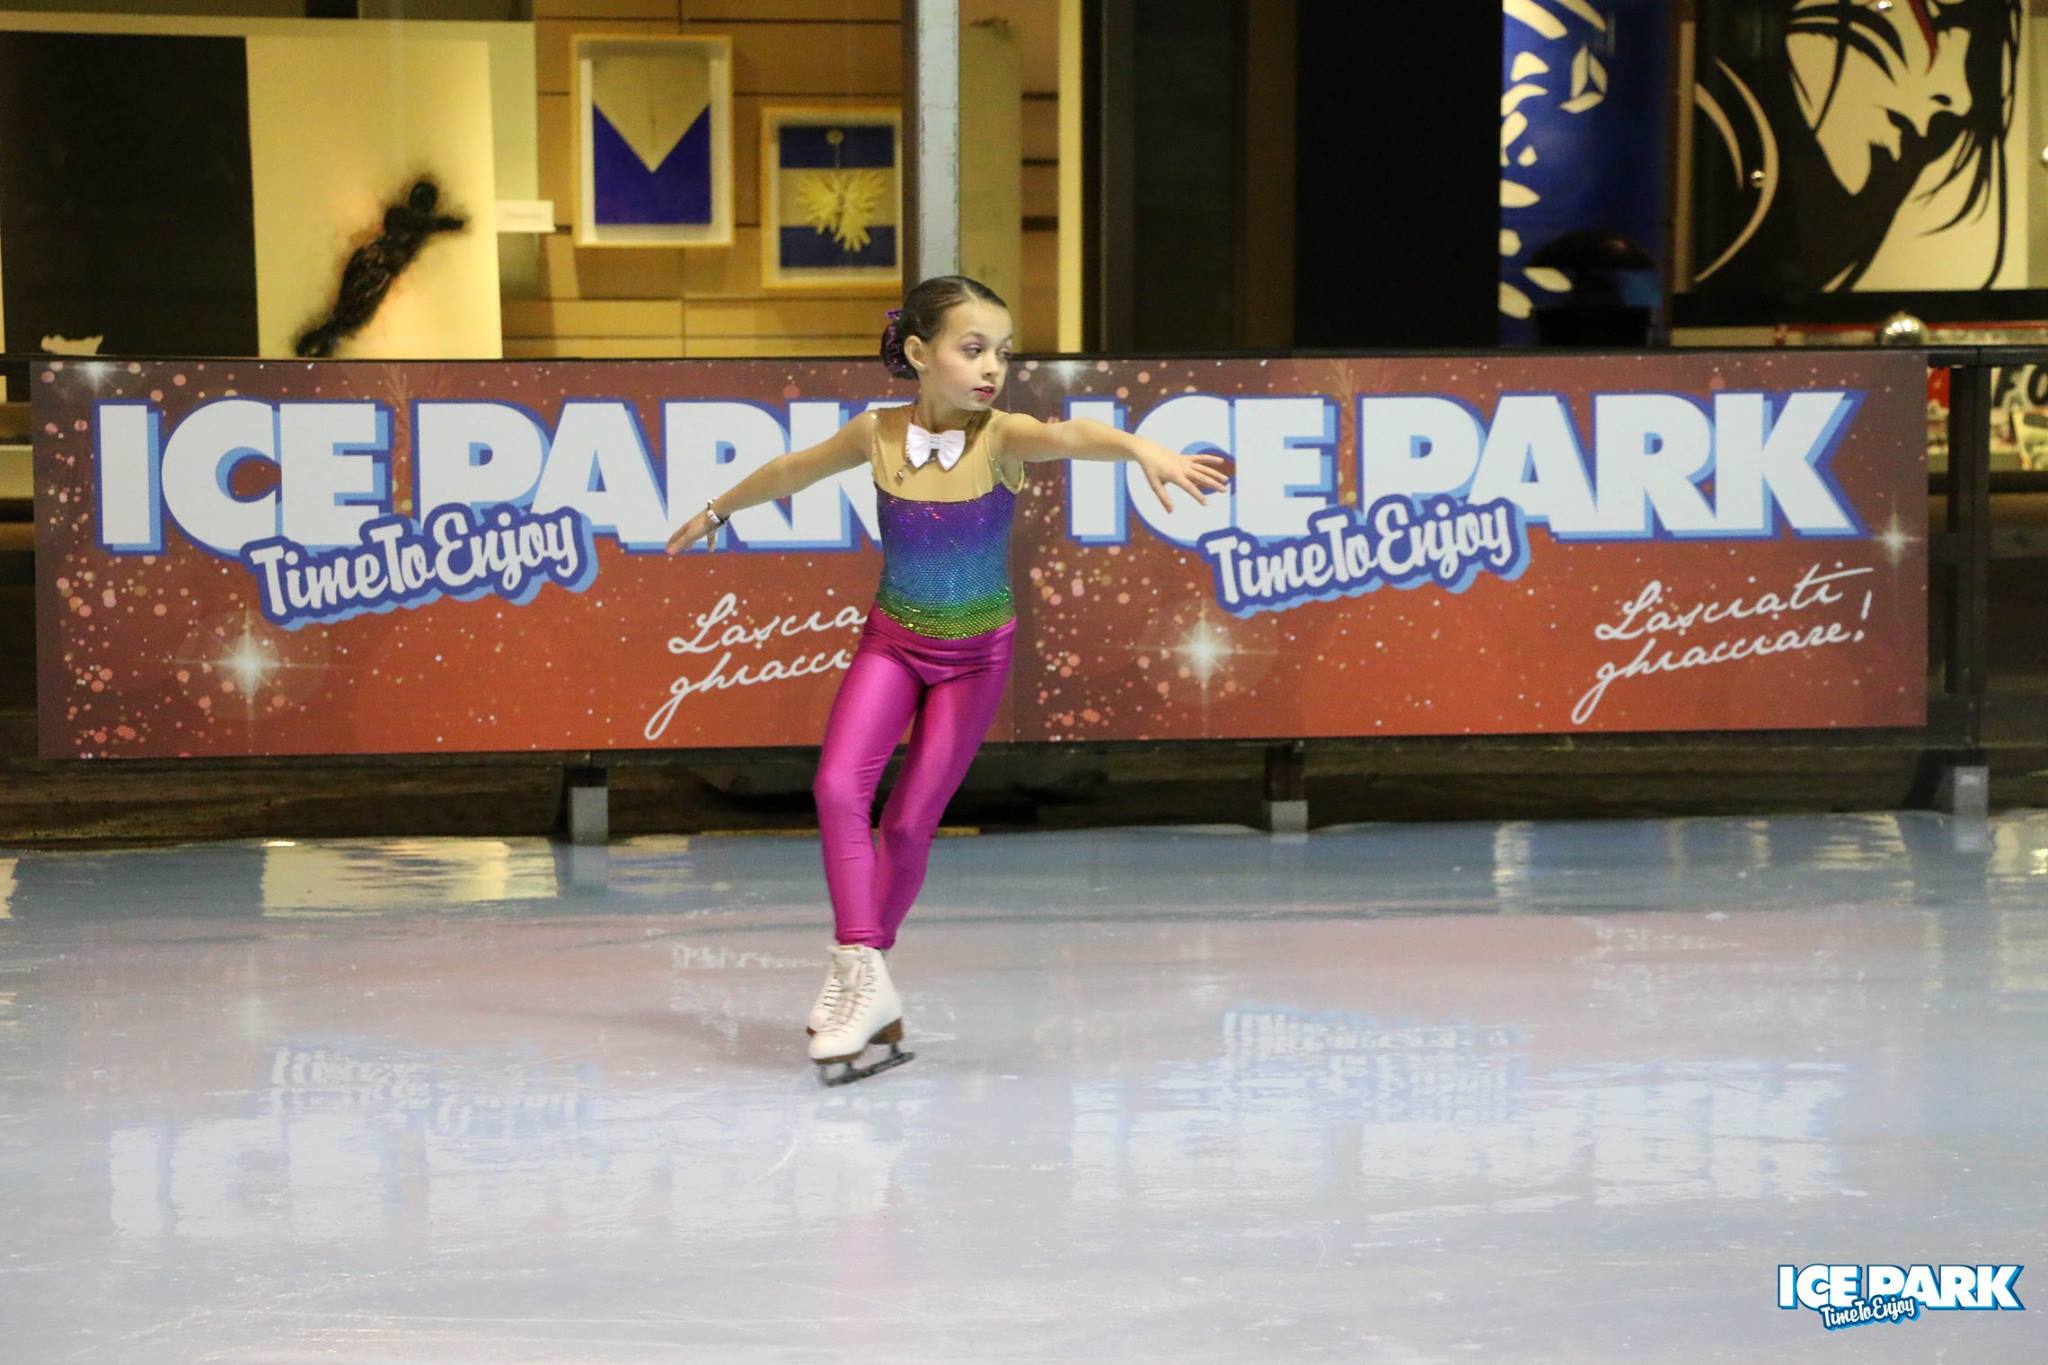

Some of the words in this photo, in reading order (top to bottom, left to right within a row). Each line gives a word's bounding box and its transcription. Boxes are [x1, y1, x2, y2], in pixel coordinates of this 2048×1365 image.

[98, 399, 386, 555] ICE
[1068, 395, 1332, 545] ICE
[1361, 391, 1860, 535] PARK
[667, 592, 868, 655] Lascia
[1594, 562, 1875, 640] Lasciati
[644, 651, 852, 741] ghiacci
